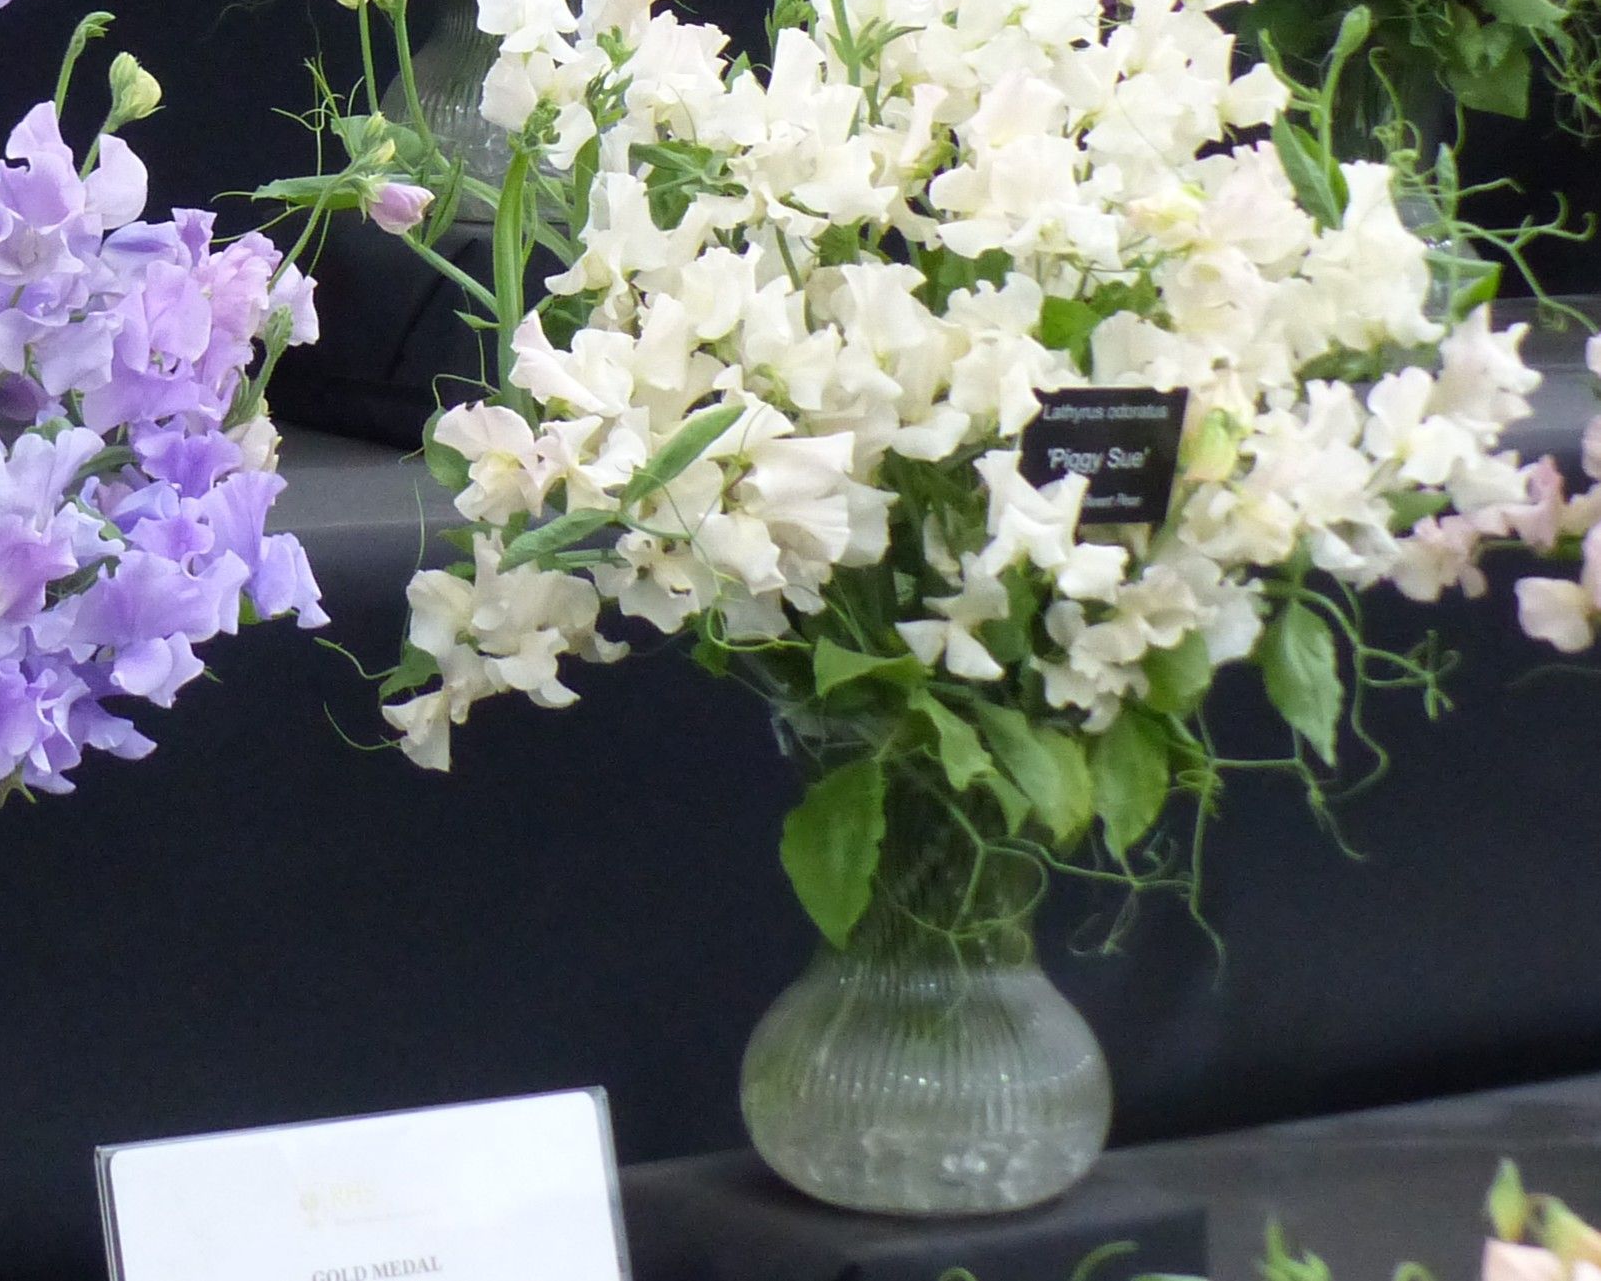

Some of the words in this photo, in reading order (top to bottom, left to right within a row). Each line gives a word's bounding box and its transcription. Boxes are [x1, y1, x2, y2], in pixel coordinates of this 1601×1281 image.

[1106, 446, 1151, 469] Sue'
[311, 1265, 367, 1281] GOLD
[372, 1255, 444, 1279] MEDAL
